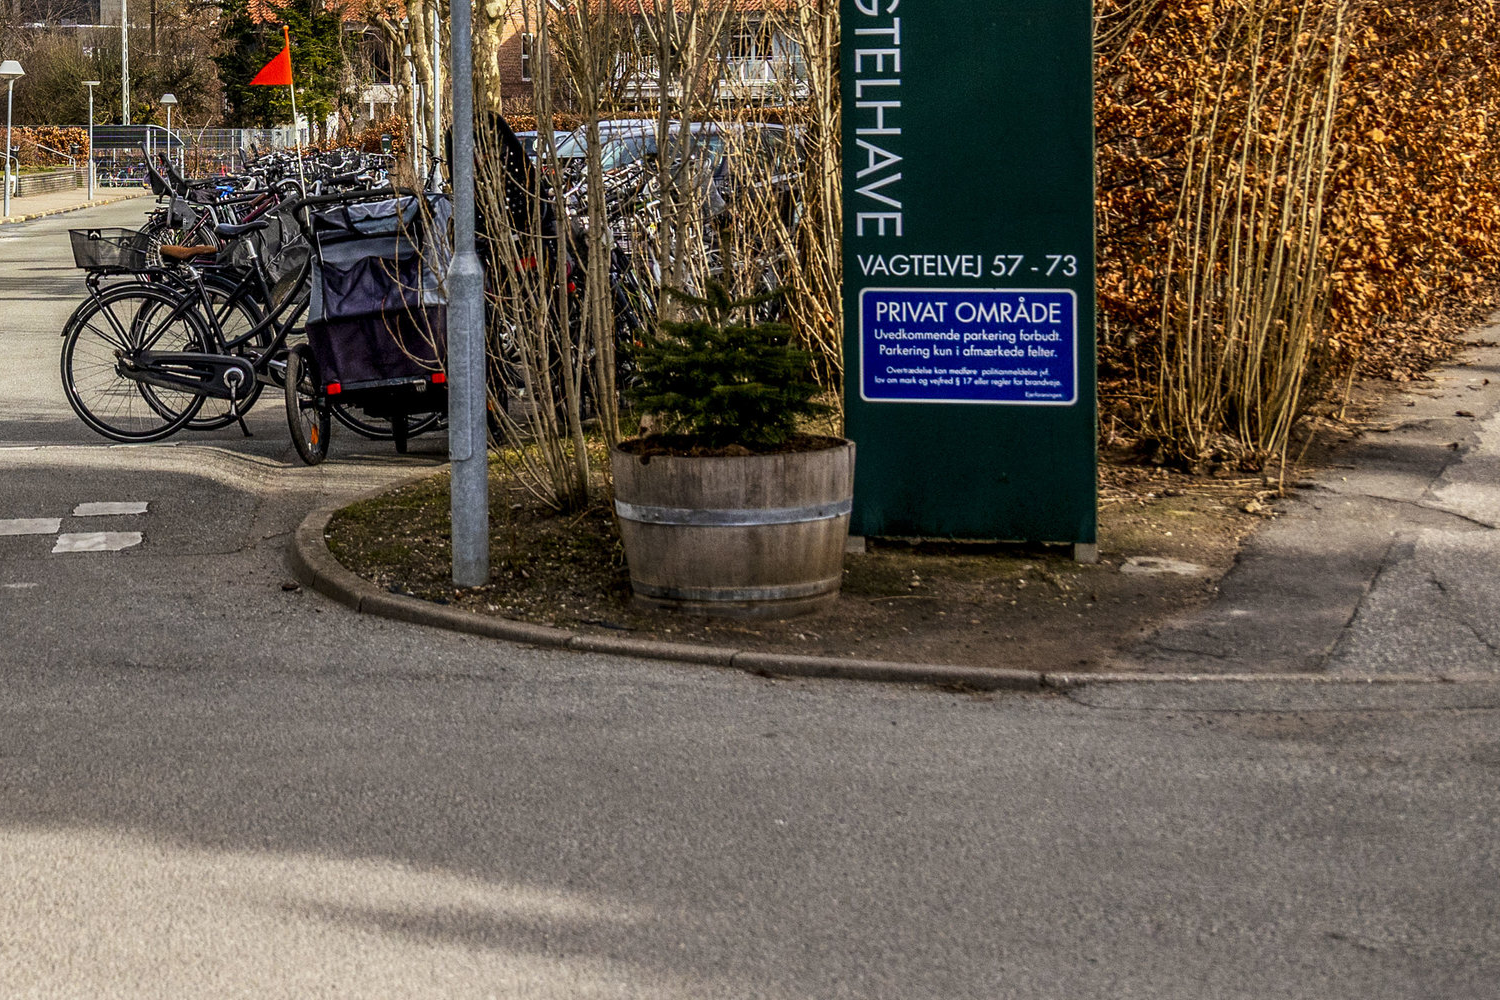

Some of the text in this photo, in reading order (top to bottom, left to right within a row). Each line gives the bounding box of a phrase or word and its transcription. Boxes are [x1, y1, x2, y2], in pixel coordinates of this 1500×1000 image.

[857, 254, 982, 278] VAGTELVEJ
[990, 254, 1024, 277] 57
[1045, 254, 1077, 277] 73
[876, 296, 1062, 324] PRIVAT OMRÅDE
[874, 328, 1063, 343] Uvedkommende parkering forbudt.
[879, 344, 1058, 359] Parkering kun i afmærkede felter.
[886, 366, 933, 375] Overtrædelse
[934, 366, 947, 375] kan
[948, 367, 978, 375] medføre
[874, 376, 885, 384] lov
[899, 376, 917, 384] mark
[918, 378, 928, 386] og
[955, 377, 960, 386] §
[963, 377, 973, 385] 17
[974, 377, 989, 386] eller
[991, 378, 1012, 388] regler
[1013, 378, 1023, 386] for
